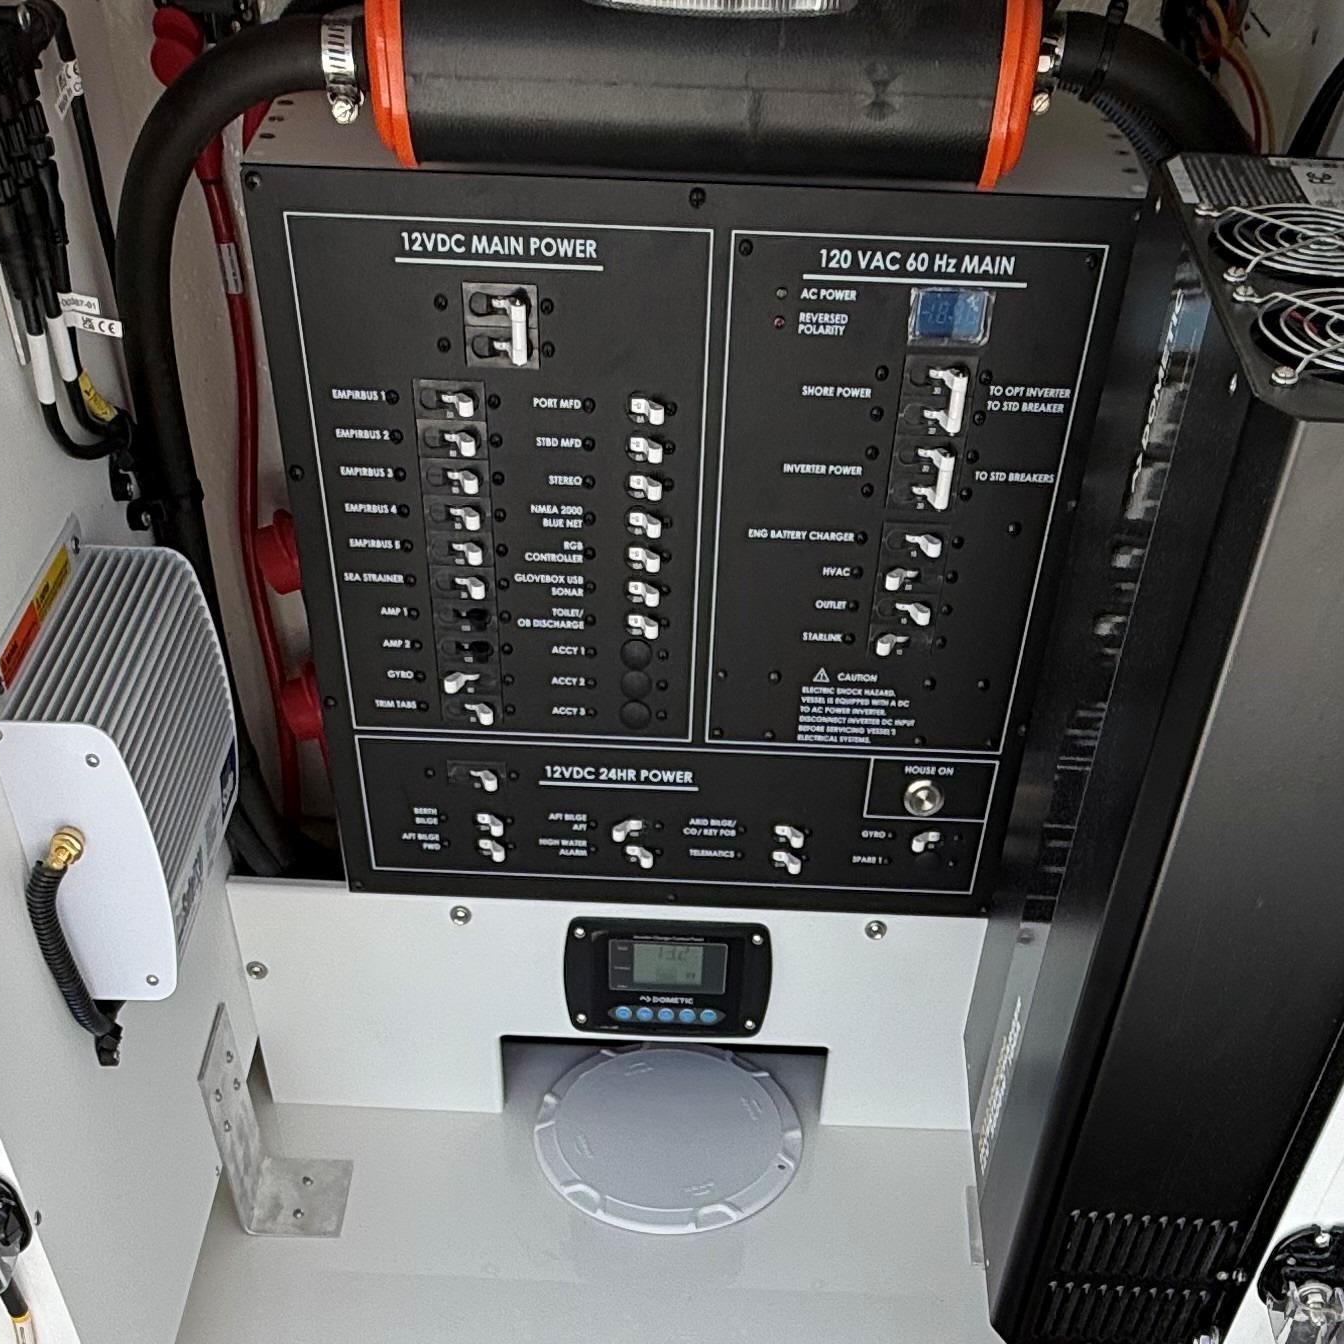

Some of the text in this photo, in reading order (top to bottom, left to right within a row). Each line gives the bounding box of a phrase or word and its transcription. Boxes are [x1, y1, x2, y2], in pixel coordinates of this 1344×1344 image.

[401, 231, 596, 258] 12VDC MAIN POWER
[818, 248, 1015, 275] 120 VAC 60 Hz MAIN
[801, 288, 856, 300] AC POWER
[799, 312, 848, 325] REVERSED
[798, 325, 845, 335] POLARITY
[332, 389, 386, 401] EMPIRBUS 1
[802, 386, 871, 398] SHORE POWER
[990, 386, 1071, 398] TO OPT INVERTER
[533, 397, 581, 409] PORT MFD
[987, 401, 1064, 413] TO STD BREAKER
[336, 429, 389, 440] EMPIRBUS 2
[536, 437, 582, 448] STBD MFD
[340, 466, 393, 477] EMPIRBUS 3
[784, 464, 862, 475] INVERTER POWER
[549, 475, 582, 485] STEREO
[976, 471, 1054, 483] TO STD BREAKERS
[345, 503, 397, 513] EMPIRBUS 4
[531, 504, 583, 515] NMEA 2000
[543, 518, 583, 528] BLUE NET
[749, 528, 854, 541] ENG BATTERY CHARGER
[349, 539, 400, 549] EMPIRBUS 5
[564, 541, 583, 550] RGB
[525, 552, 583, 563] CONTROLLER
[823, 567, 850, 576] HVAC
[344, 572, 404, 583] SEA STRAINER
[514, 573, 583, 584] GLOVEBOX USB
[552, 587, 583, 596] SONAR
[815, 600, 847, 609] OUTLET
[381, 607, 401, 615] AMP
[533, 619, 584, 629] DISCHARGE
[803, 632, 842, 642] STARLINK
[405, 640, 410, 648] 2
[552, 646, 578, 654] ACCY
[387, 670, 414, 679] GYRO
[837, 672, 877, 682] CAUTION
[552, 677, 585, 686] ACCY 2
[375, 699, 416, 709] TRIM TABS
[552, 707, 578, 715] ACCY
[811, 706, 824, 714] AC
[825, 706, 851, 715] POWER
[545, 766, 692, 783] 12VDC 24HR POWER
[905, 766, 954, 775] HOUSE ON
[862, 830, 886, 838] GYRO
[689, 849, 734, 858] TELEMATICS
[650, 996, 693, 1004] DOMETIC
